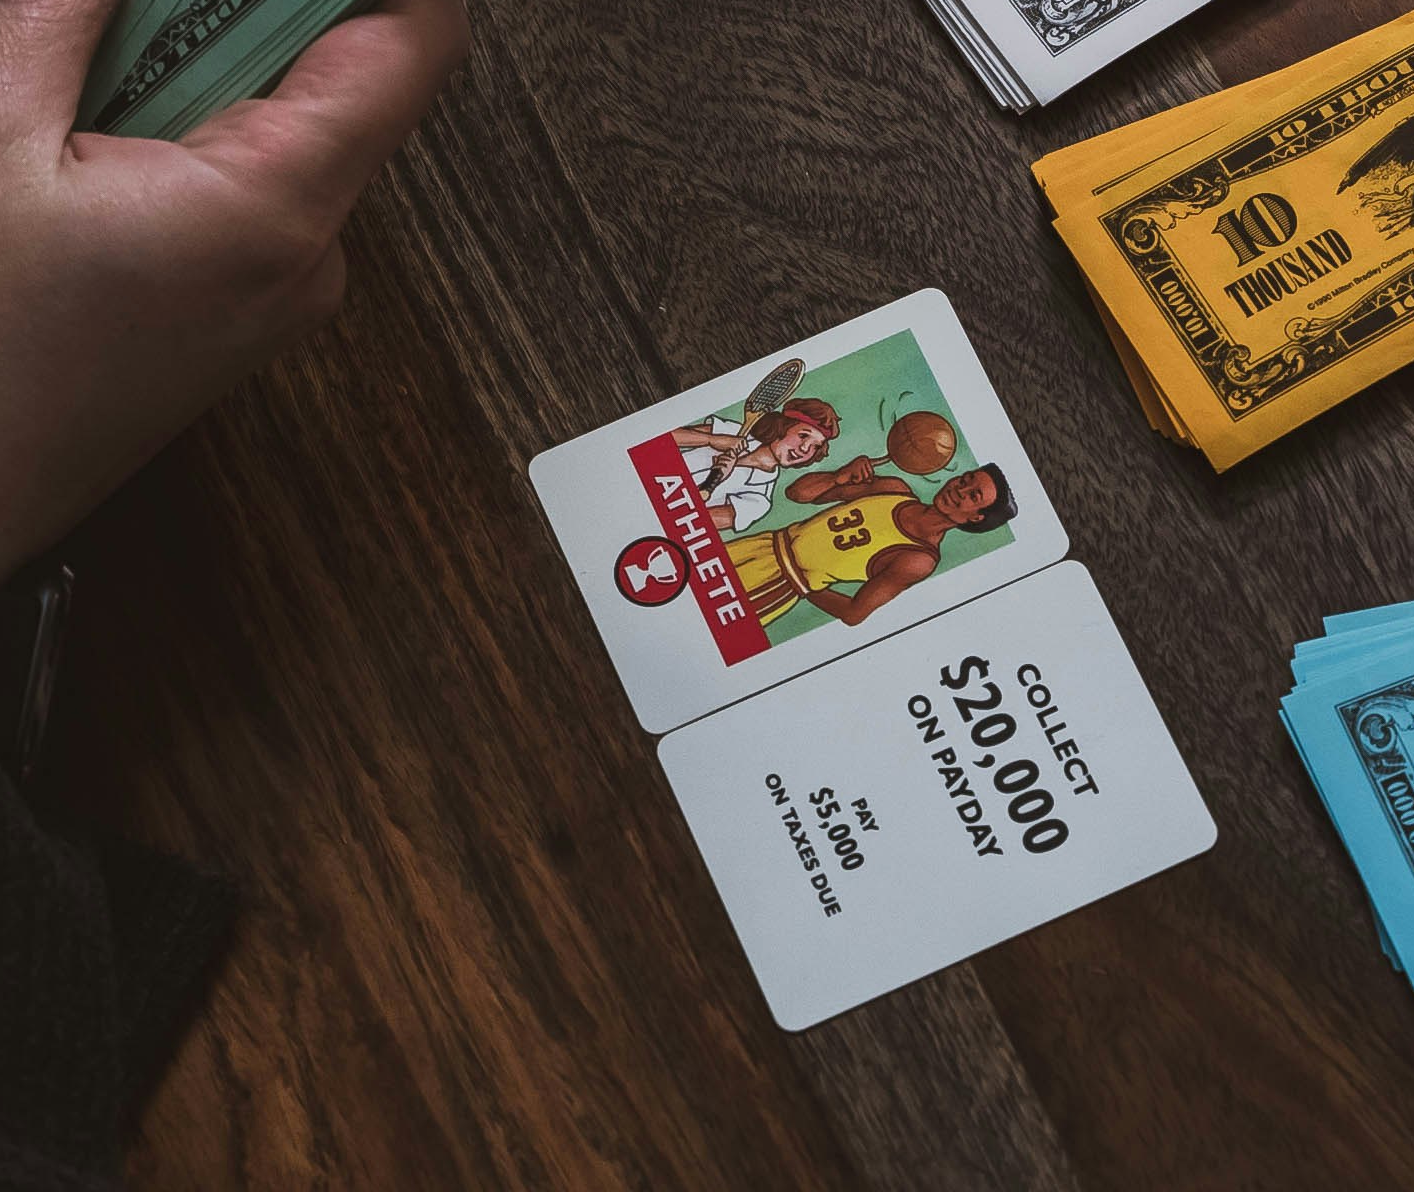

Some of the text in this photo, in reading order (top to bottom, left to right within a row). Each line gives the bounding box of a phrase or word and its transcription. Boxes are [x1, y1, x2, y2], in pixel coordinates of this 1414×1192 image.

[1267, 119, 1307, 147] 10
[1211, 192, 1297, 267] 10
[1223, 228, 1353, 318] THOUSAND
[1331, 280, 1354, 298] Milton
[1354, 266, 1381, 284] Bradley
[1380, 248, 1414, 271] Company
[654, 475, 746, 626] ATHLETE
[827, 508, 871, 551] 33
[940, 655, 1069, 854] $20,000
[1017, 663, 1099, 795] COLLECT
[851, 797, 879, 831] PAY
[907, 694, 1003, 857] ON PAYDAY
[765, 774, 842, 918] ON TAXES DUE
[809, 786, 865, 871] $5,000
